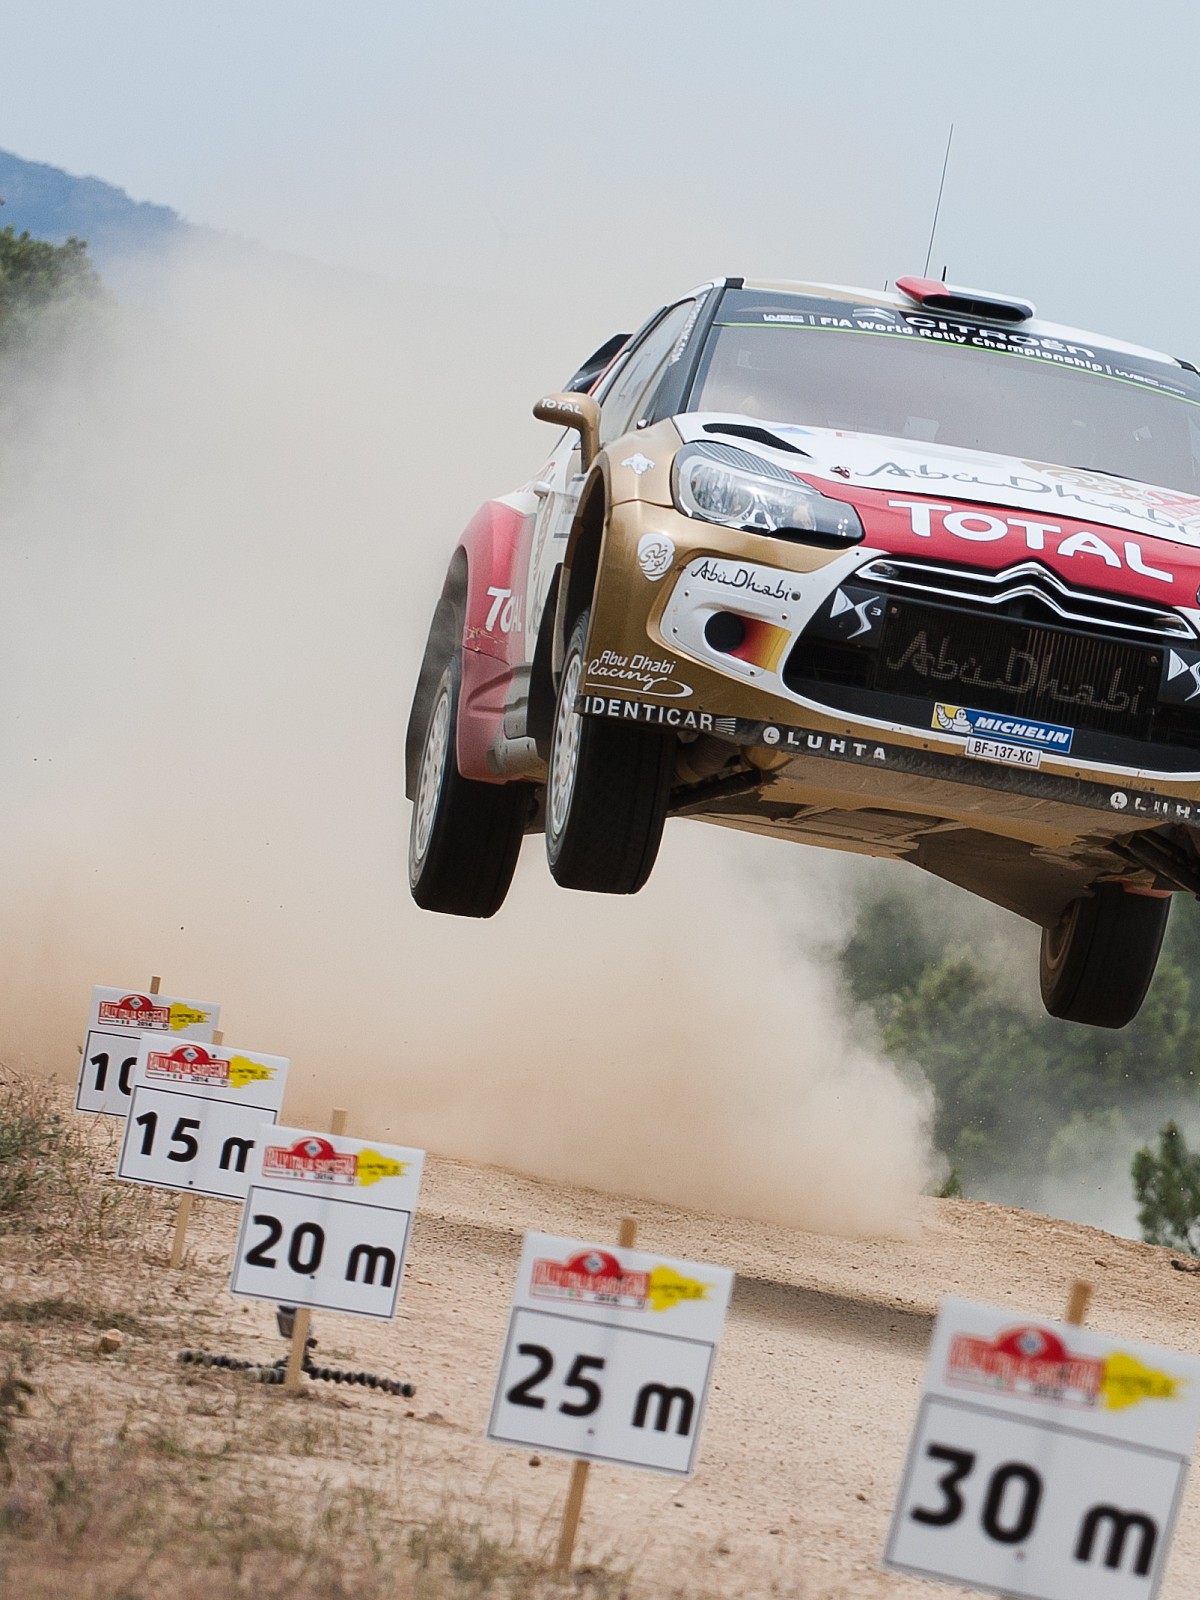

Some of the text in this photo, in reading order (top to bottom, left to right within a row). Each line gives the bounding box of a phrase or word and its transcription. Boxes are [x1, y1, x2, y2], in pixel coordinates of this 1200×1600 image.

[820, 316, 853, 328] FIA
[857, 320, 914, 336] World
[919, 328, 967, 343] Rally
[971, 337, 1103, 372] Championship
[541, 398, 583, 415] TOTAL
[888, 499, 1174, 583] TOTAL
[587, 658, 668, 693] Racing
[600, 650, 677, 674] Abu Dhabi
[584, 695, 713, 731] IDENTICAR
[973, 716, 1071, 744] MICHELIN
[787, 730, 886, 761] LUHTA
[973, 743, 1034, 764] BF-137-XC
[135, 1111, 201, 1163] 15
[244, 1214, 397, 1288] 20 m
[505, 1342, 697, 1437] 25 m
[910, 1442, 1160, 1577] 30 m
